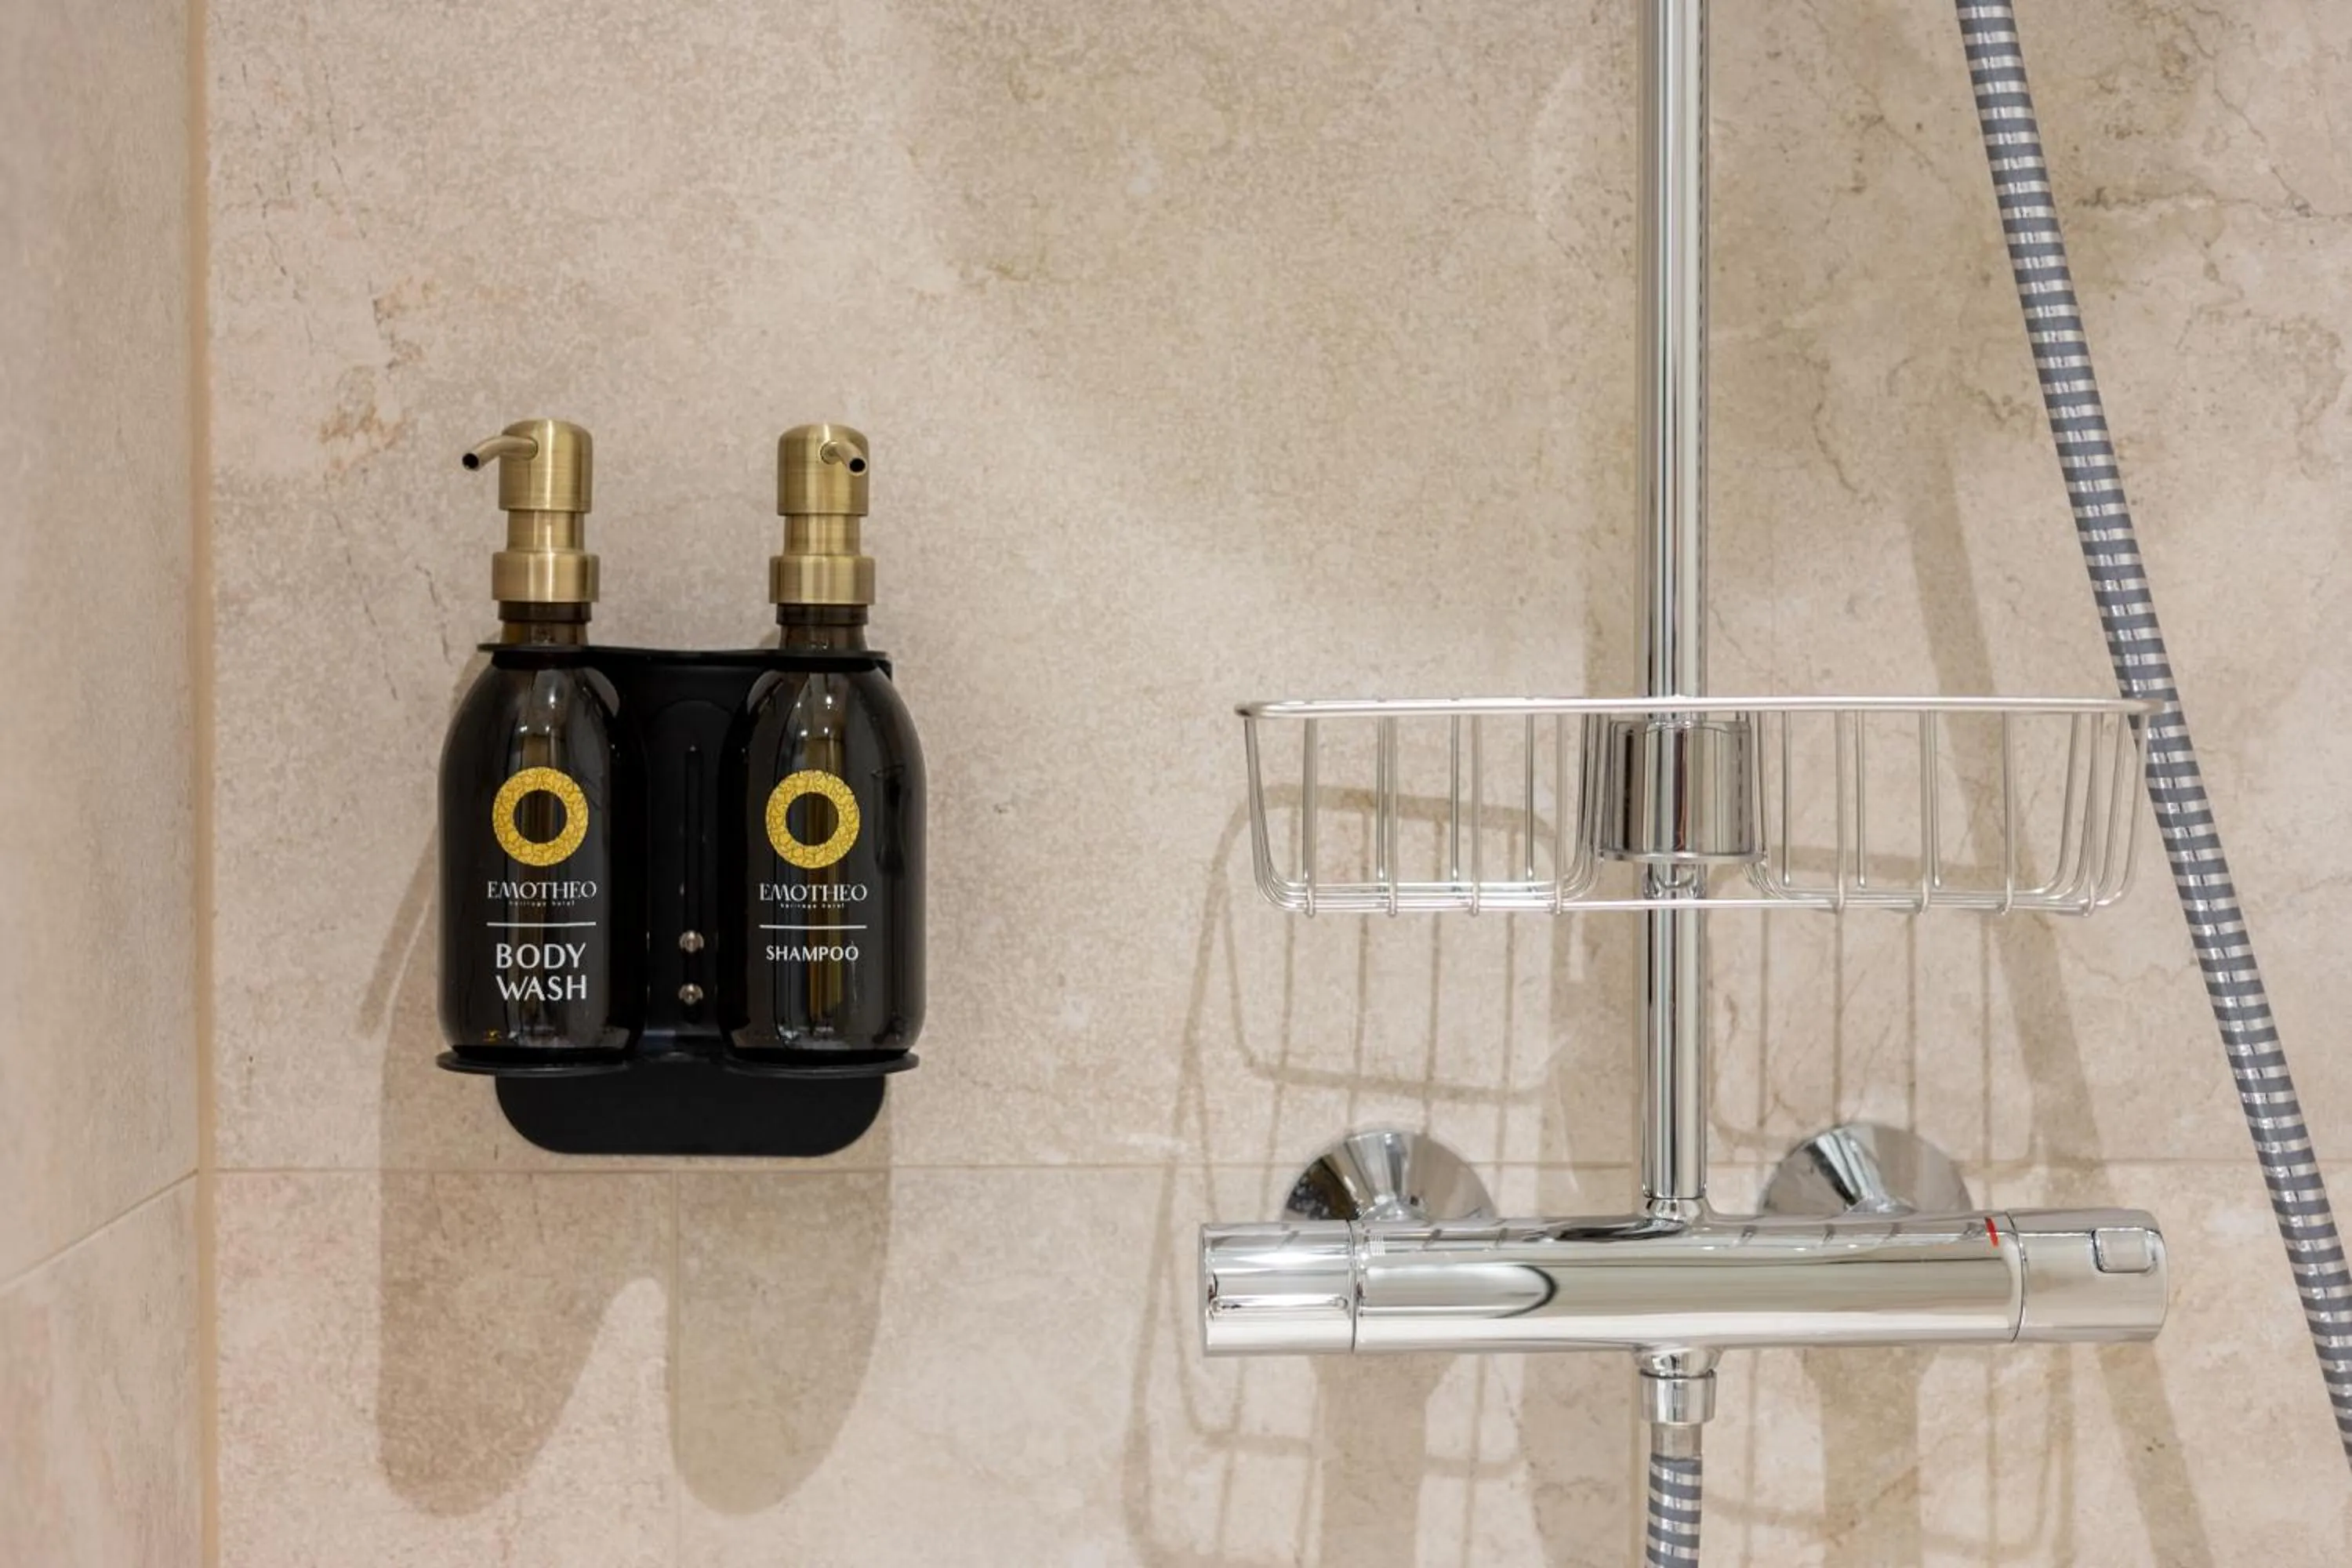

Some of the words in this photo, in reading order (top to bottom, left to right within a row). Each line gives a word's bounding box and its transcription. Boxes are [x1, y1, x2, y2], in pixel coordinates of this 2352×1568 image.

[488, 880, 597, 899] EMOTHEO
[759, 883, 868, 902] EMOTHEO
[495, 942, 587, 969] BODY
[766, 945, 859, 962] SHAMPOO
[495, 975, 587, 1001] WASH
